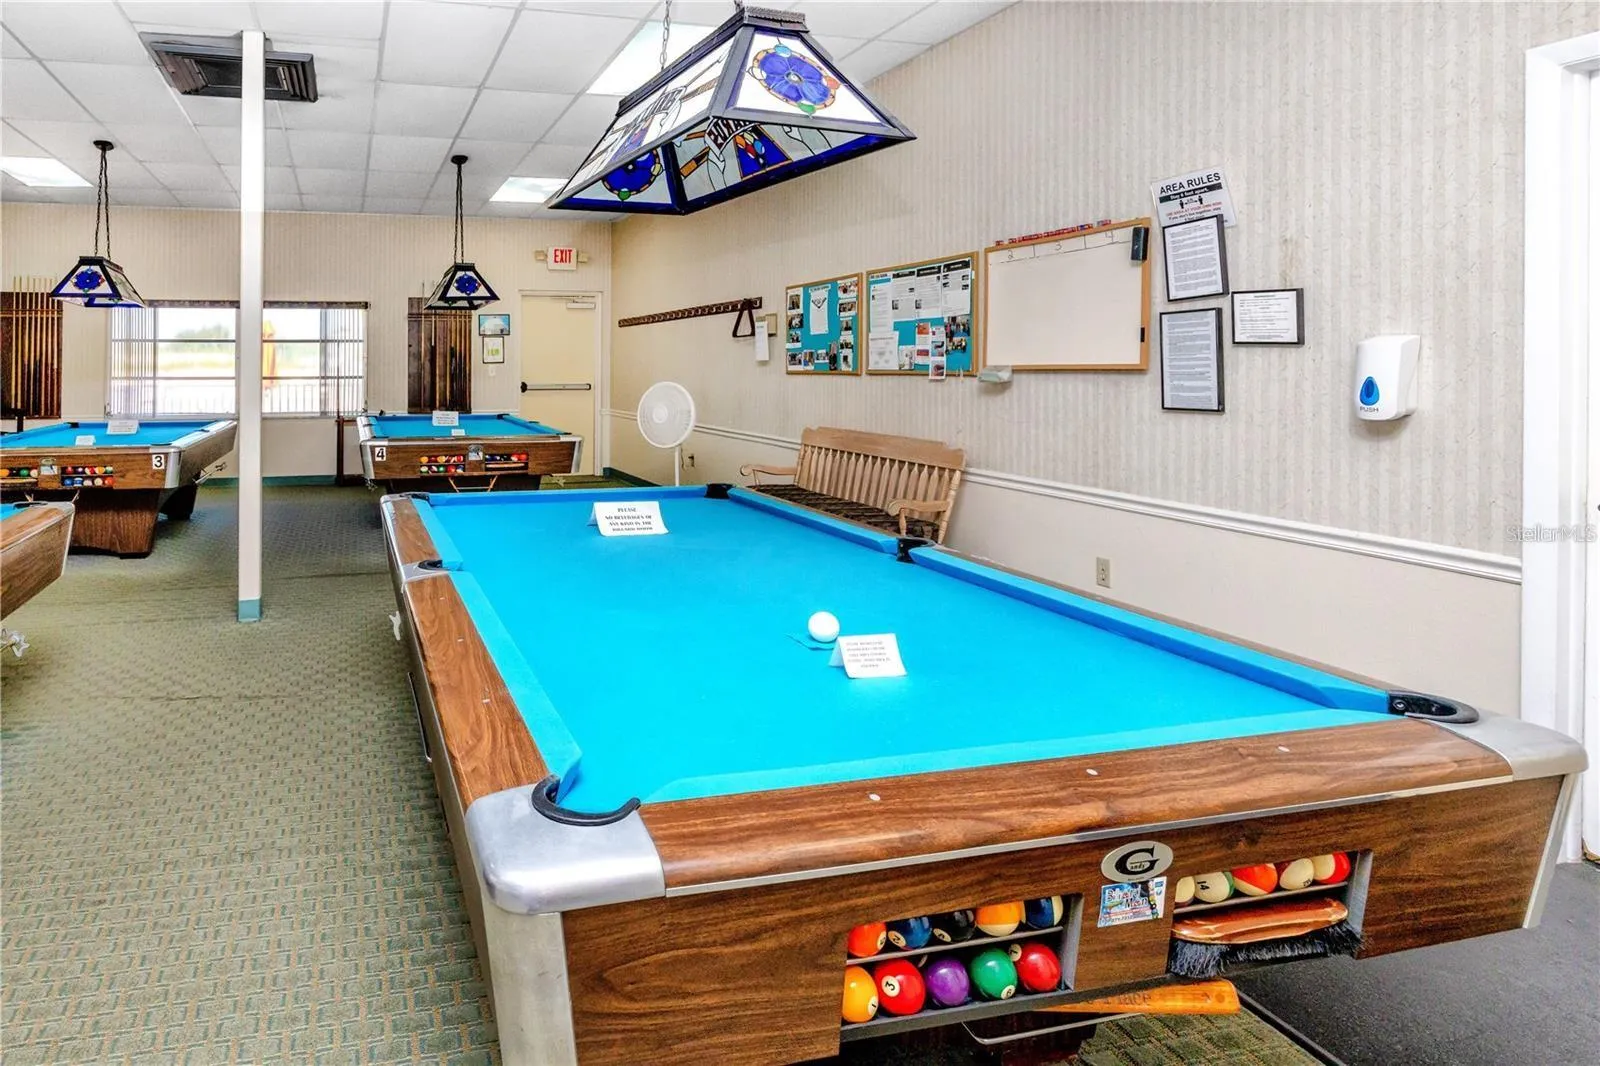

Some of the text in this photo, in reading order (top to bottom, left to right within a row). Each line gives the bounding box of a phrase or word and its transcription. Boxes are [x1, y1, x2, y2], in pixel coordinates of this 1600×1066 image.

[1160, 172, 1221, 194] AREA RULES
[553, 249, 573, 263] EXIT
[1008, 249, 1014, 259] 2
[376, 447, 385, 460] 4
[154, 455, 163, 468] 3
[1196, 880, 1210, 891] 14
[884, 981, 896, 991] 3
